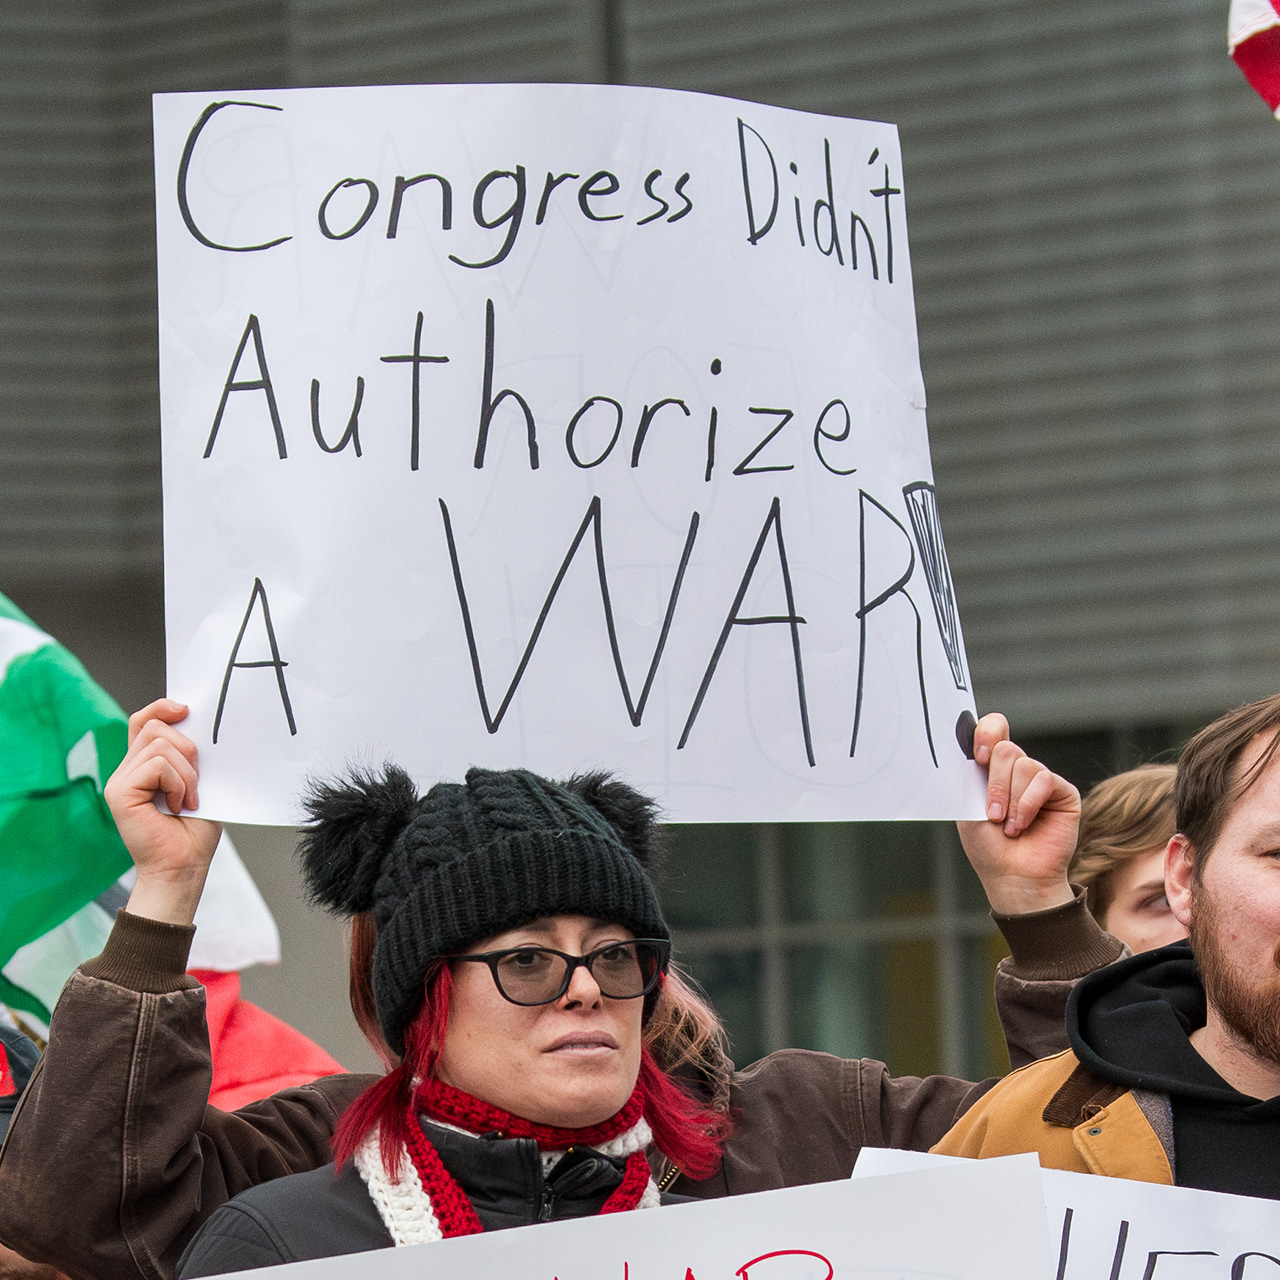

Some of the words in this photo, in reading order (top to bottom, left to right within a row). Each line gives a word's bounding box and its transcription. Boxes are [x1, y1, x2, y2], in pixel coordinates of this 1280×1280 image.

[176, 100, 694, 269] Congress
[737, 117, 902, 284] Didn't
[203, 299, 856, 482] Authorize
[213, 578, 297, 744] A
